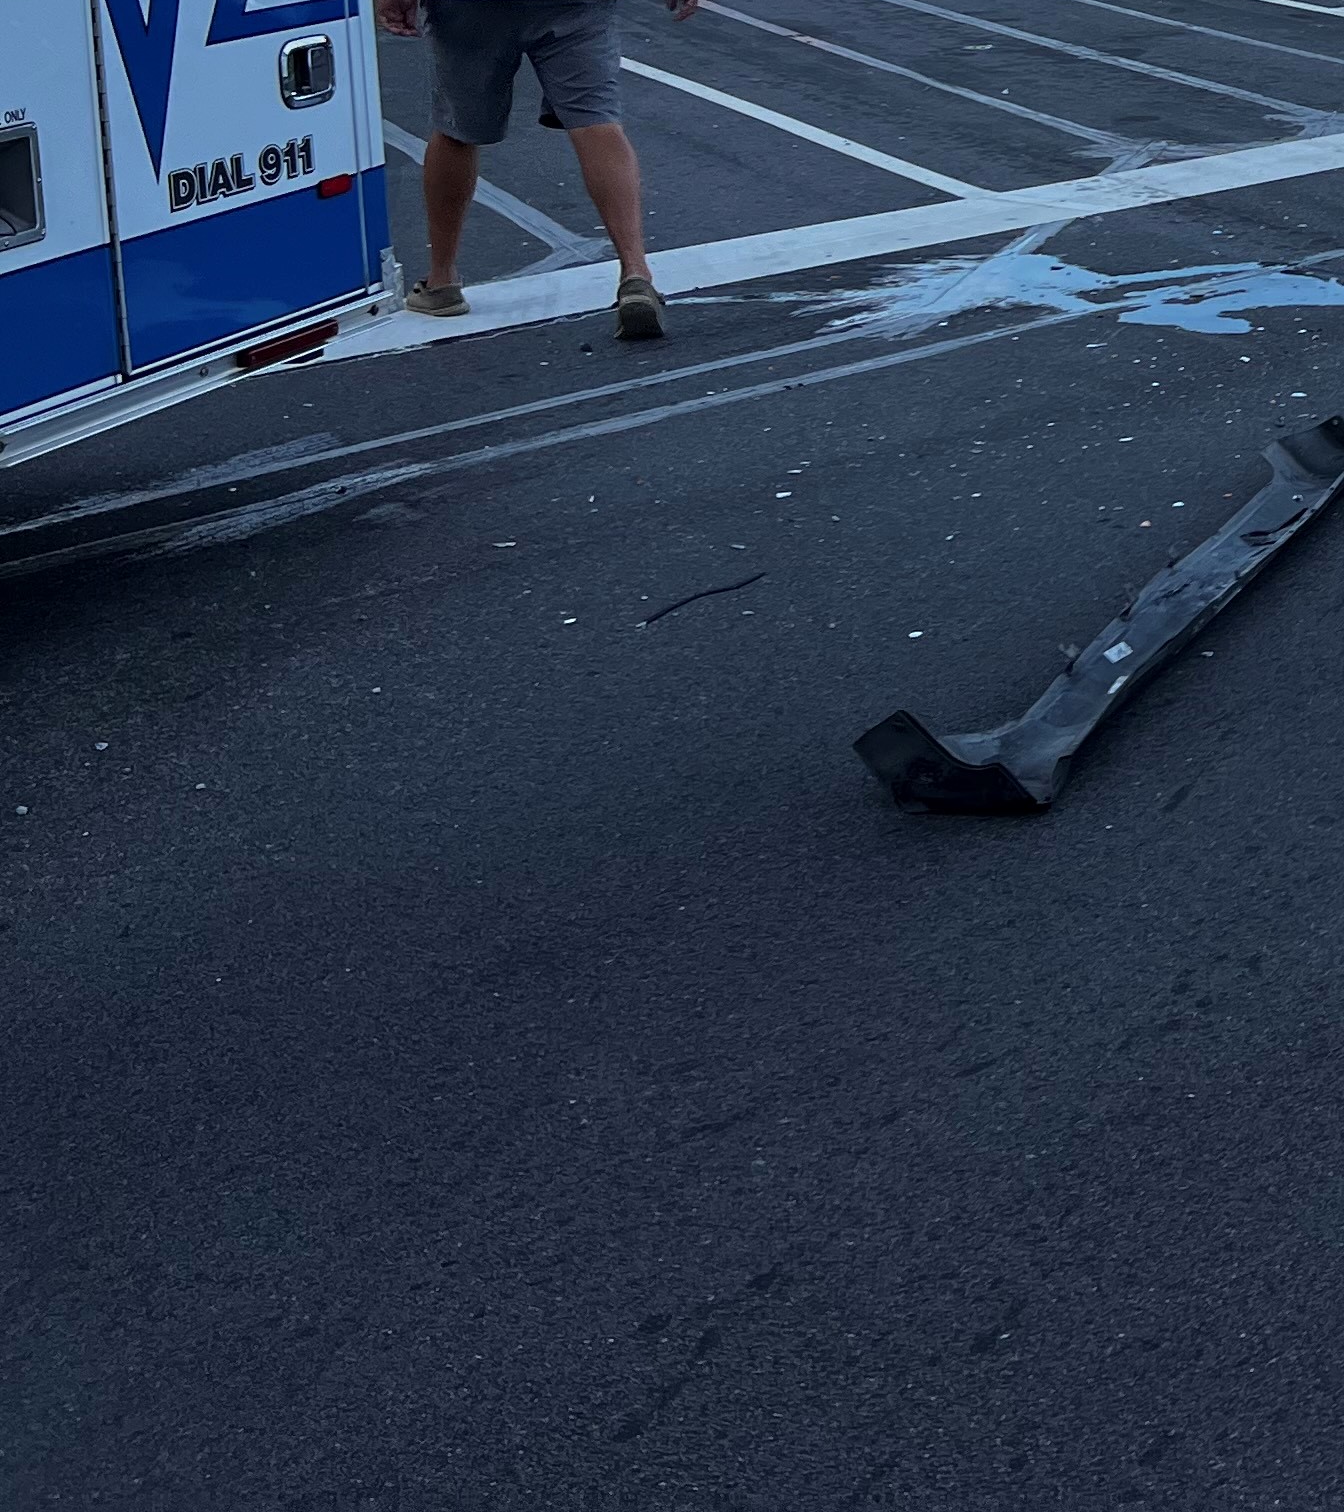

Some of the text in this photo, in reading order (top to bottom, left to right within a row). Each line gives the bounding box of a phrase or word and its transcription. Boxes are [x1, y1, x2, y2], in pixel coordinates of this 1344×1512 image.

[4, 107, 27, 124] ONLY
[168, 133, 316, 214] DIAL 911
